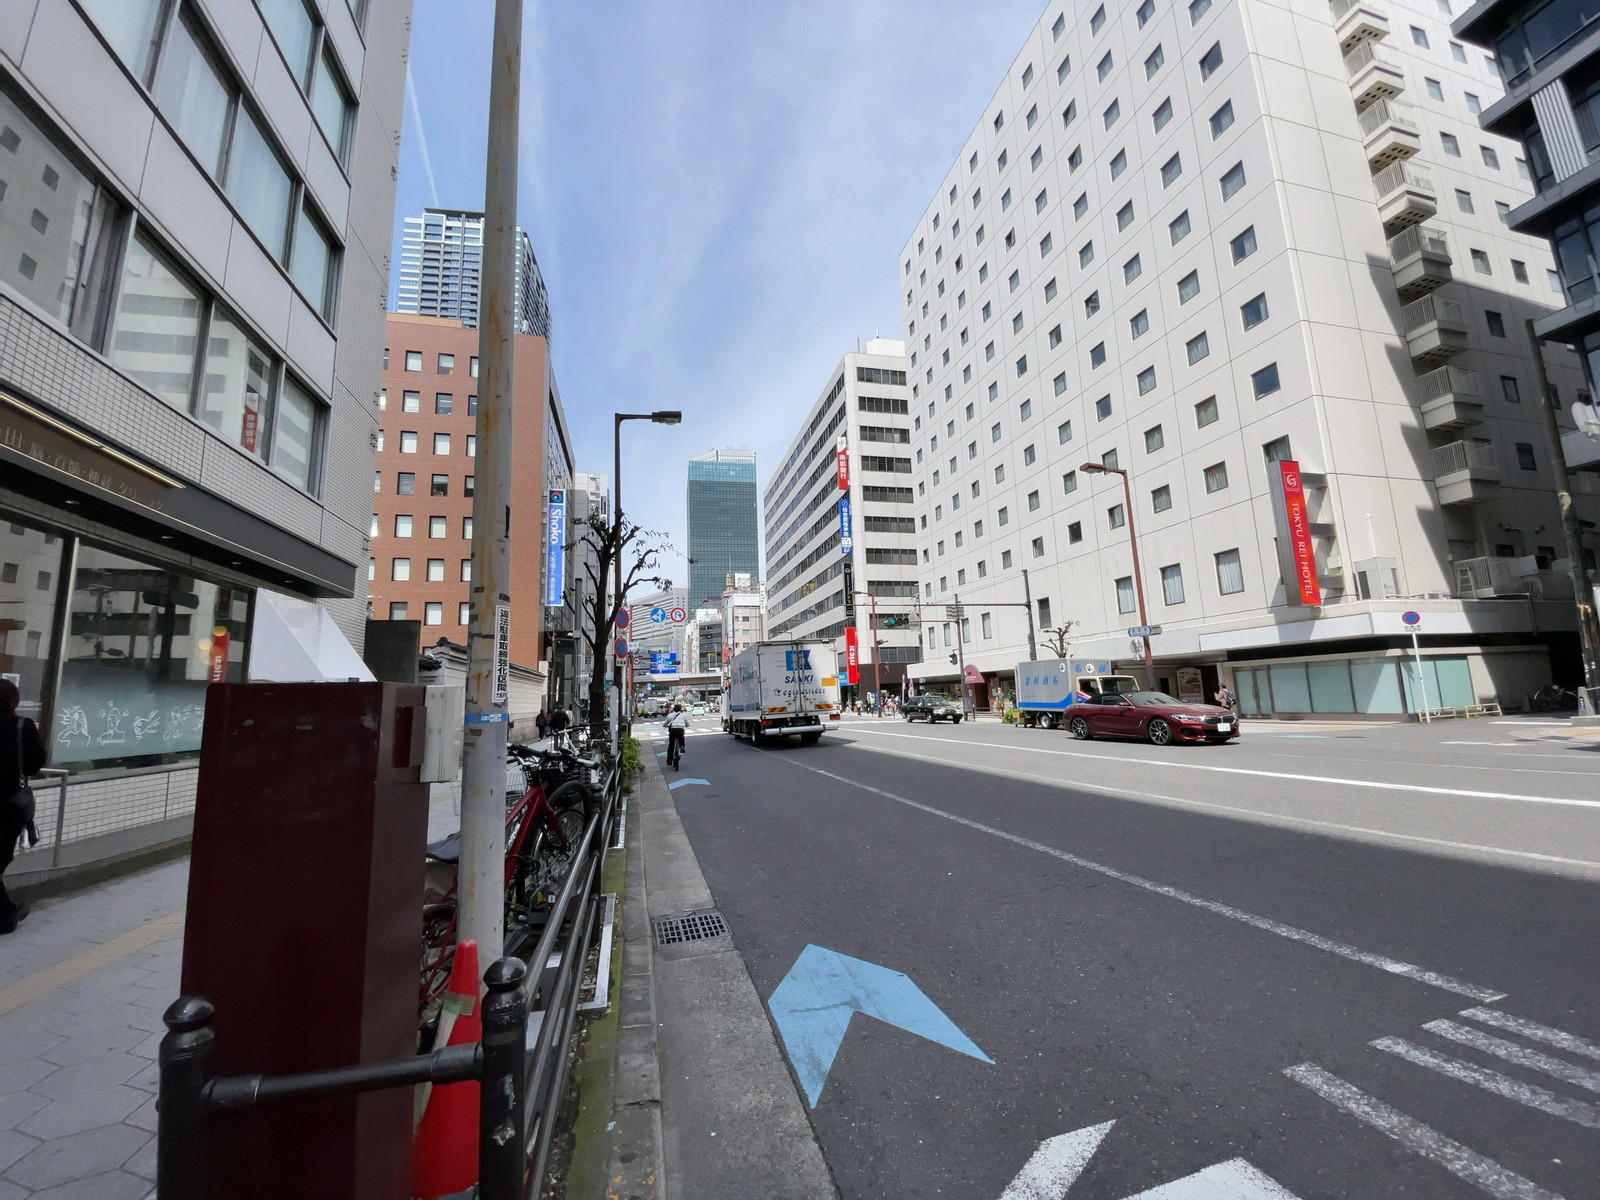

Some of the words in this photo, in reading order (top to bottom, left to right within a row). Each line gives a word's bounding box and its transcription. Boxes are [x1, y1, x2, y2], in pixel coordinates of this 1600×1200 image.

[550, 508, 562, 545] Shoko
[1292, 501, 1304, 537] TOKYU
[1298, 541, 1307, 557] REI
[1301, 562, 1313, 596] HOTEL
